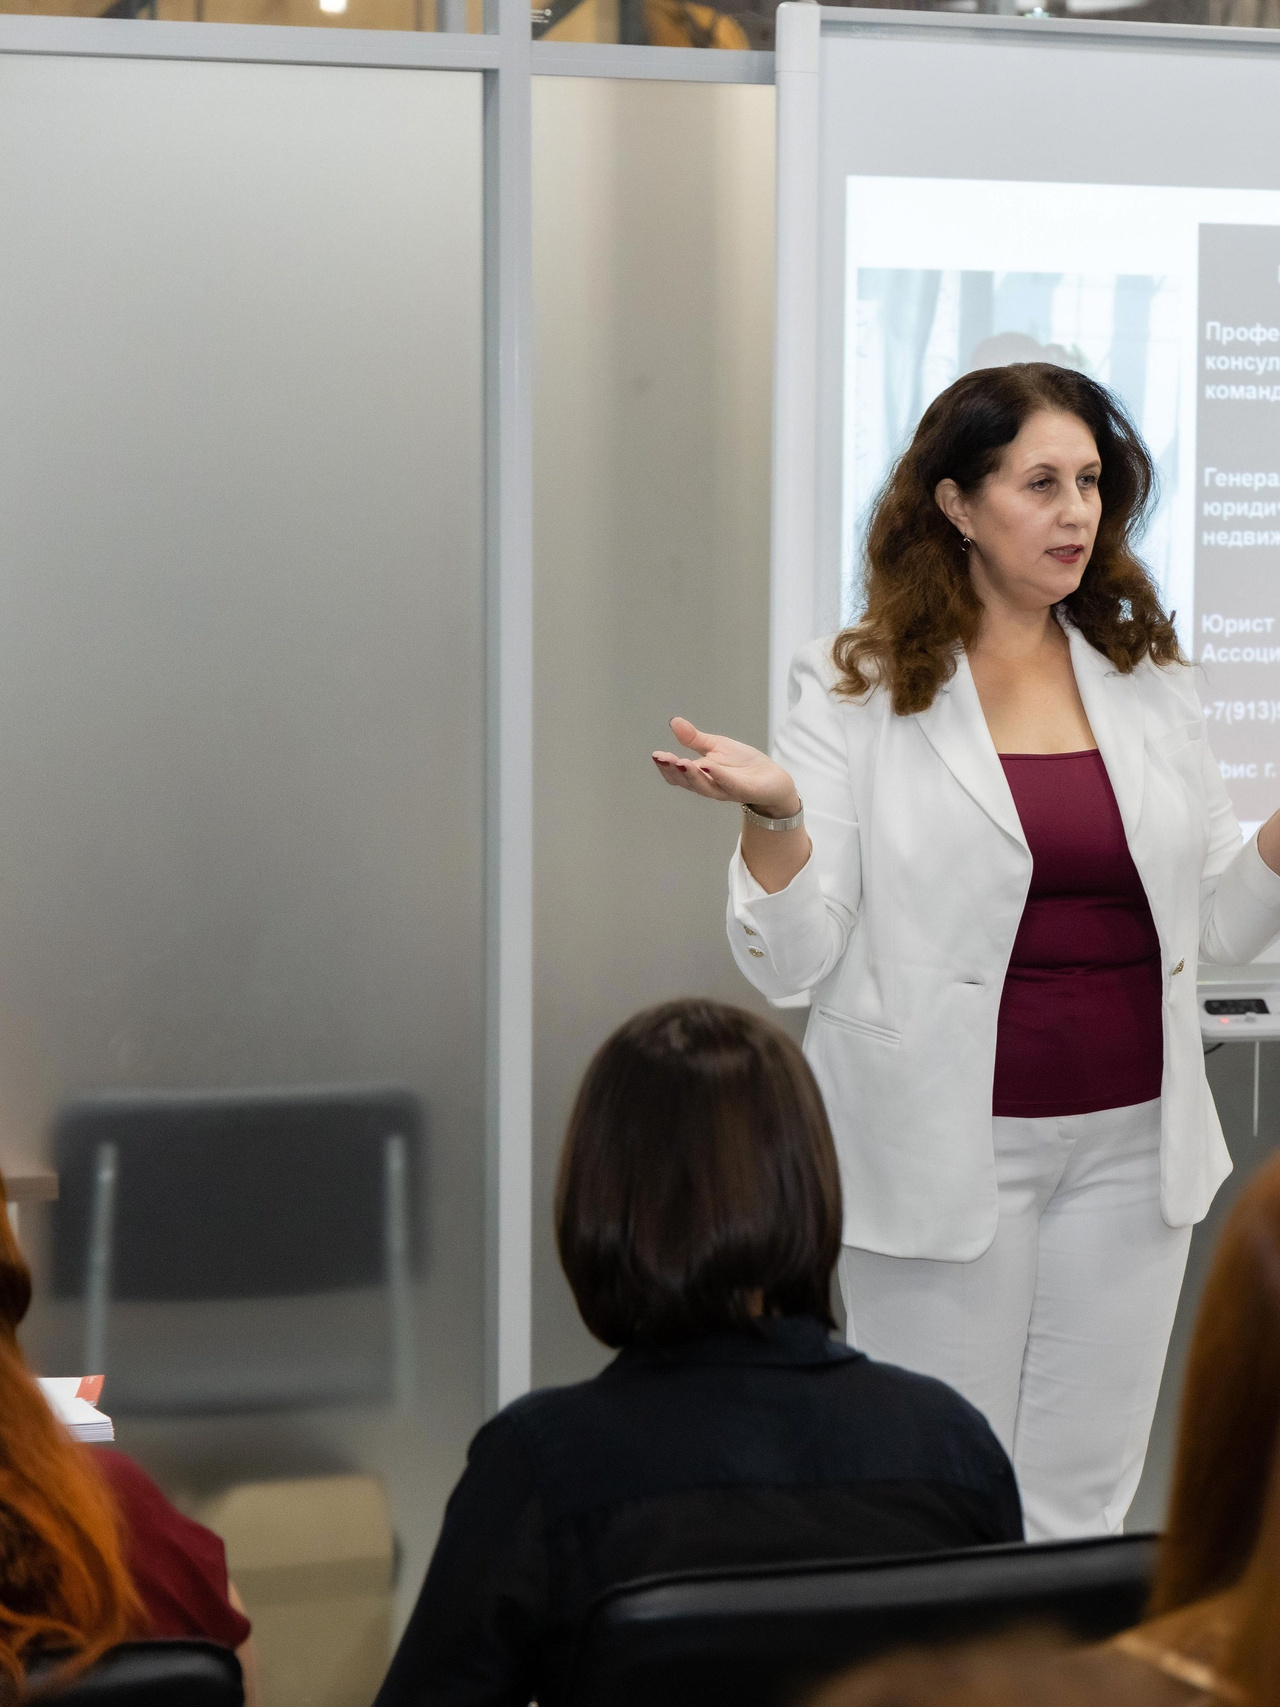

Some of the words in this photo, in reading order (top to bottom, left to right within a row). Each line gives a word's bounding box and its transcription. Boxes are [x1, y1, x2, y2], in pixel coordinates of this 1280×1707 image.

[1202, 612, 1277, 639] Юрист
[1217, 759, 1259, 781] фис
[1264, 760, 1278, 780] г.
